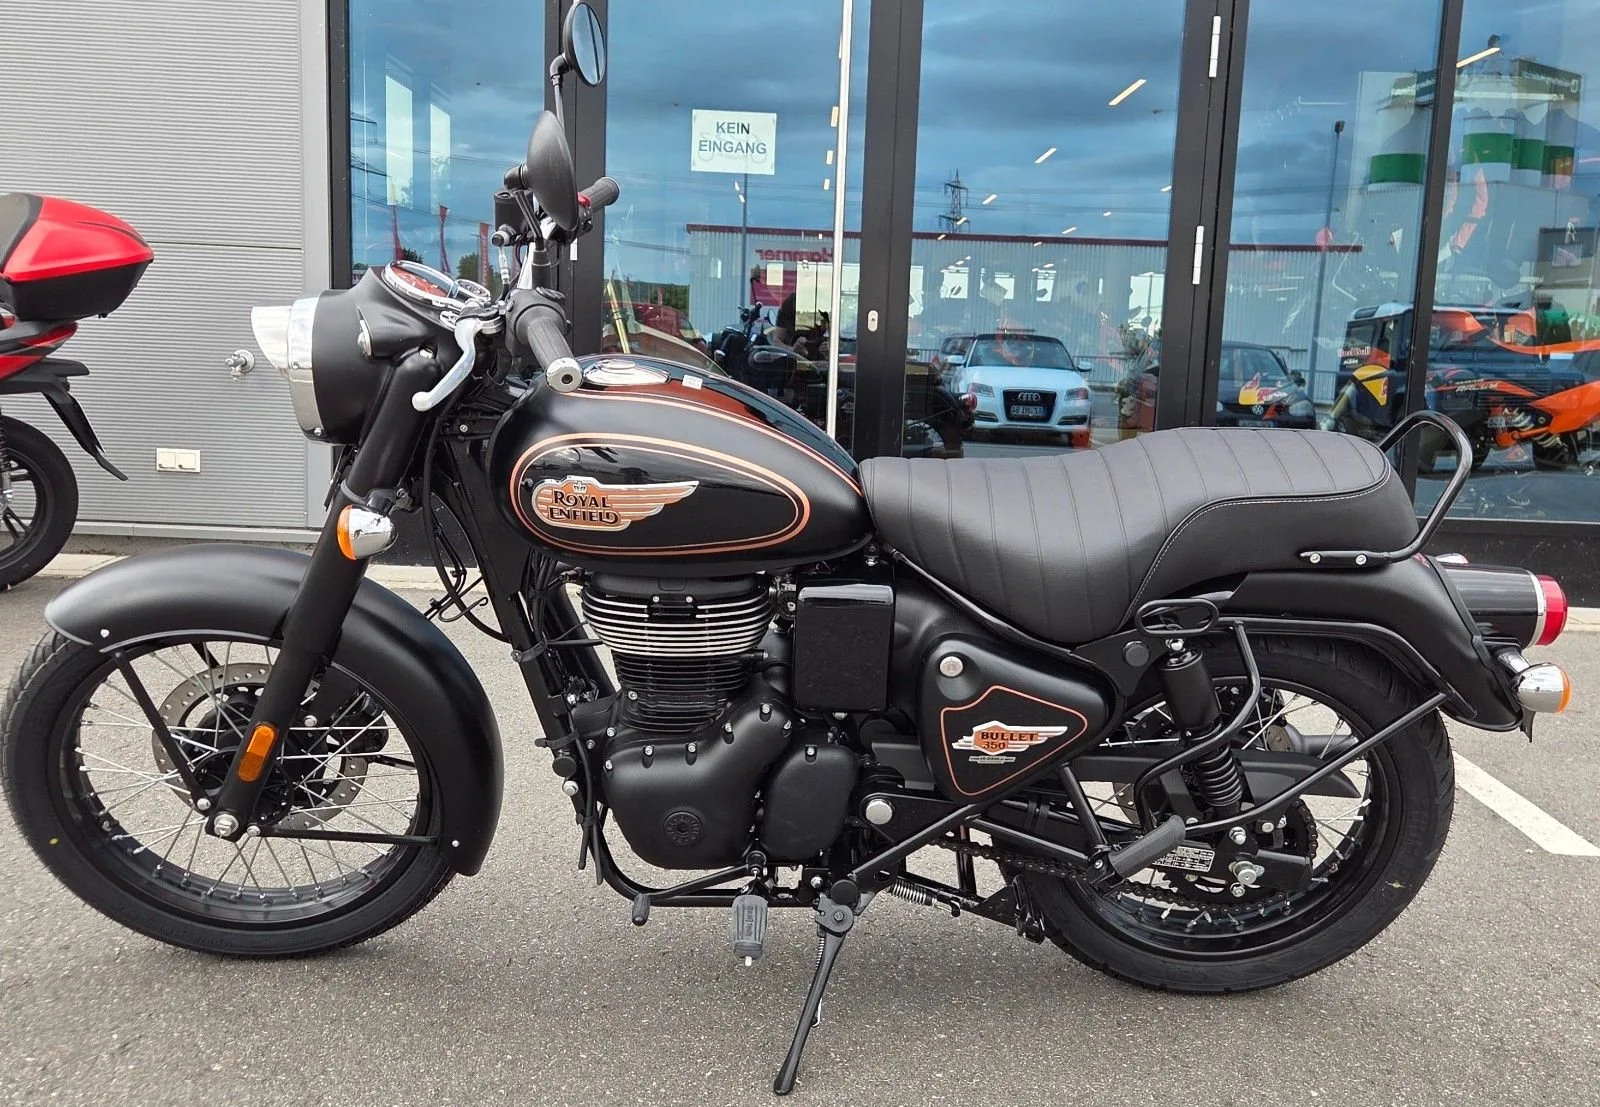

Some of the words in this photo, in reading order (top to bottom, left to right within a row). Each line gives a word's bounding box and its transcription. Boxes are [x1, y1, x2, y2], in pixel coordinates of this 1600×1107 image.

[716, 122, 750, 134] KEIN
[698, 139, 767, 154] EINGANG
[553, 490, 612, 508] ROYAL
[547, 506, 619, 524] ENFIELD
[980, 731, 1038, 741] BULLET
[983, 741, 1006, 749] 350
